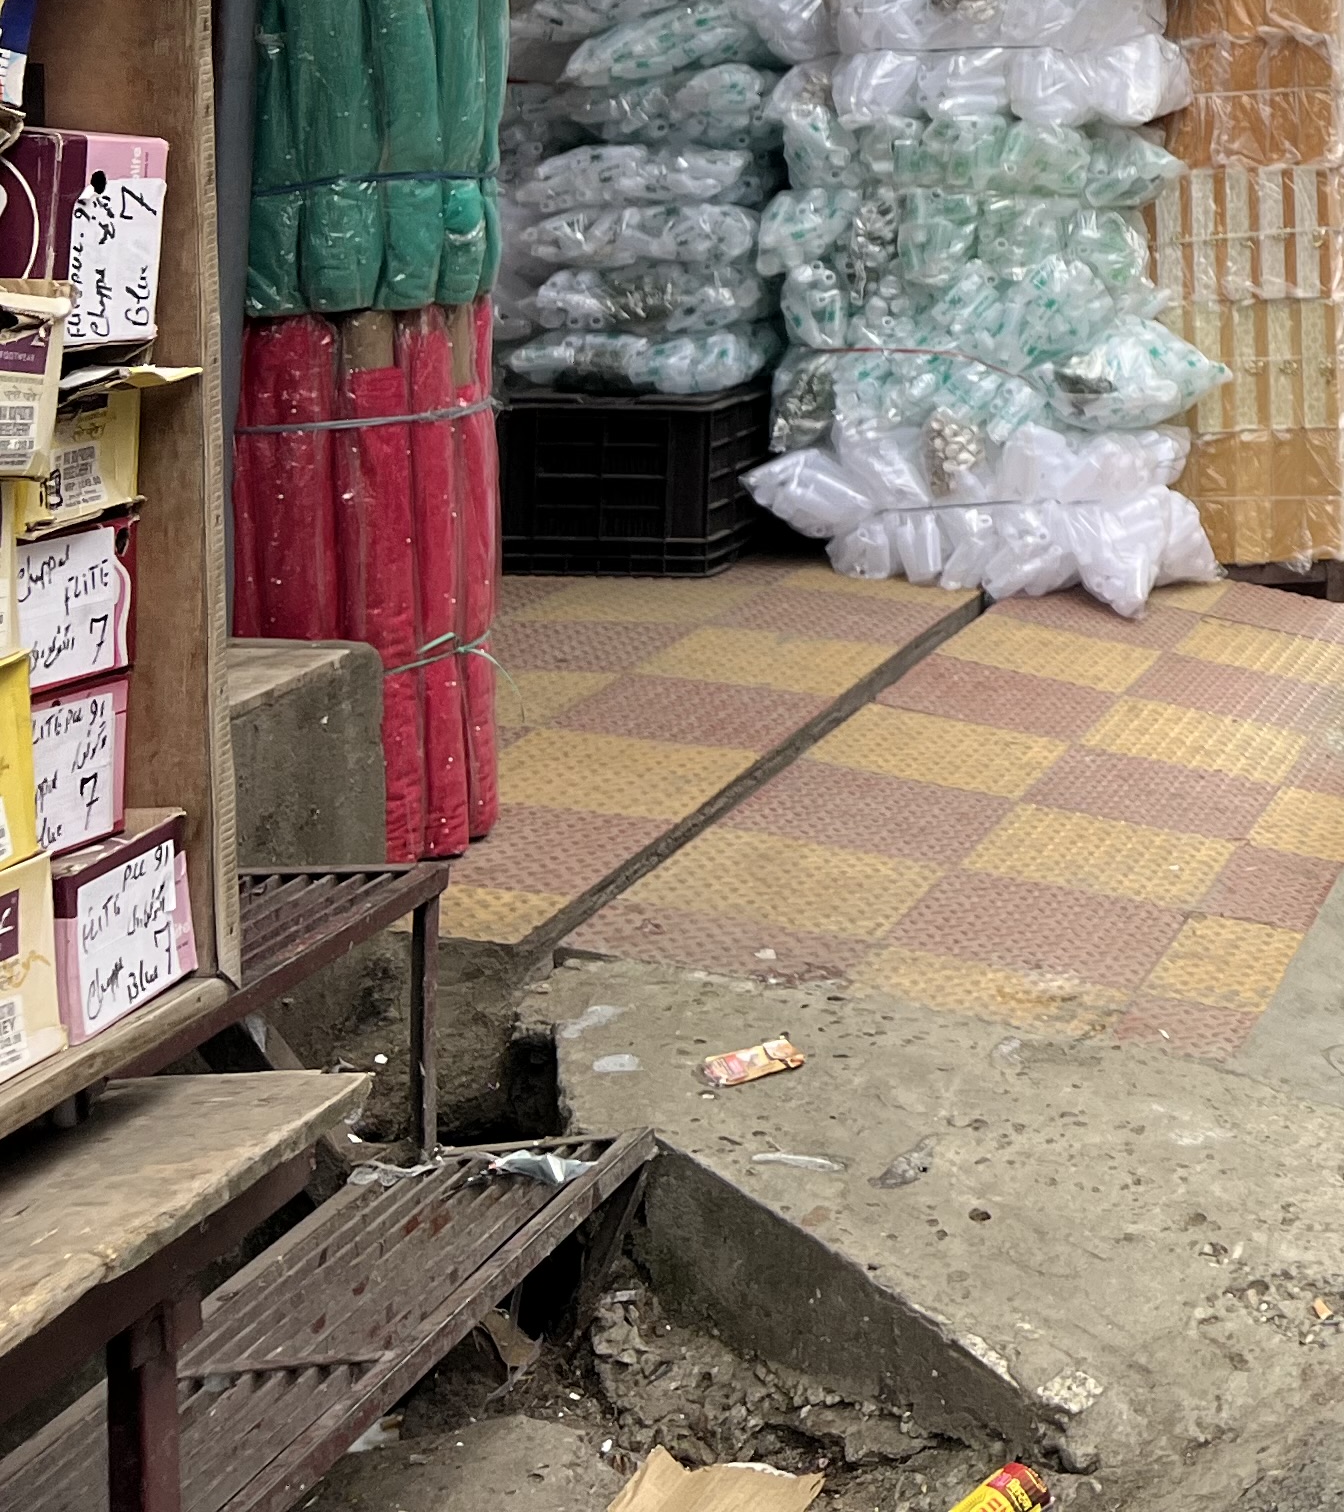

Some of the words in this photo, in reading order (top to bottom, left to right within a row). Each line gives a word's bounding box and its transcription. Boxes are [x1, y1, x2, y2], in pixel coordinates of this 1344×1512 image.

[118, 184, 158, 221] 7
[89, 613, 109, 665] 7
[79, 771, 100, 832] 7
[153, 919, 173, 975] 7
